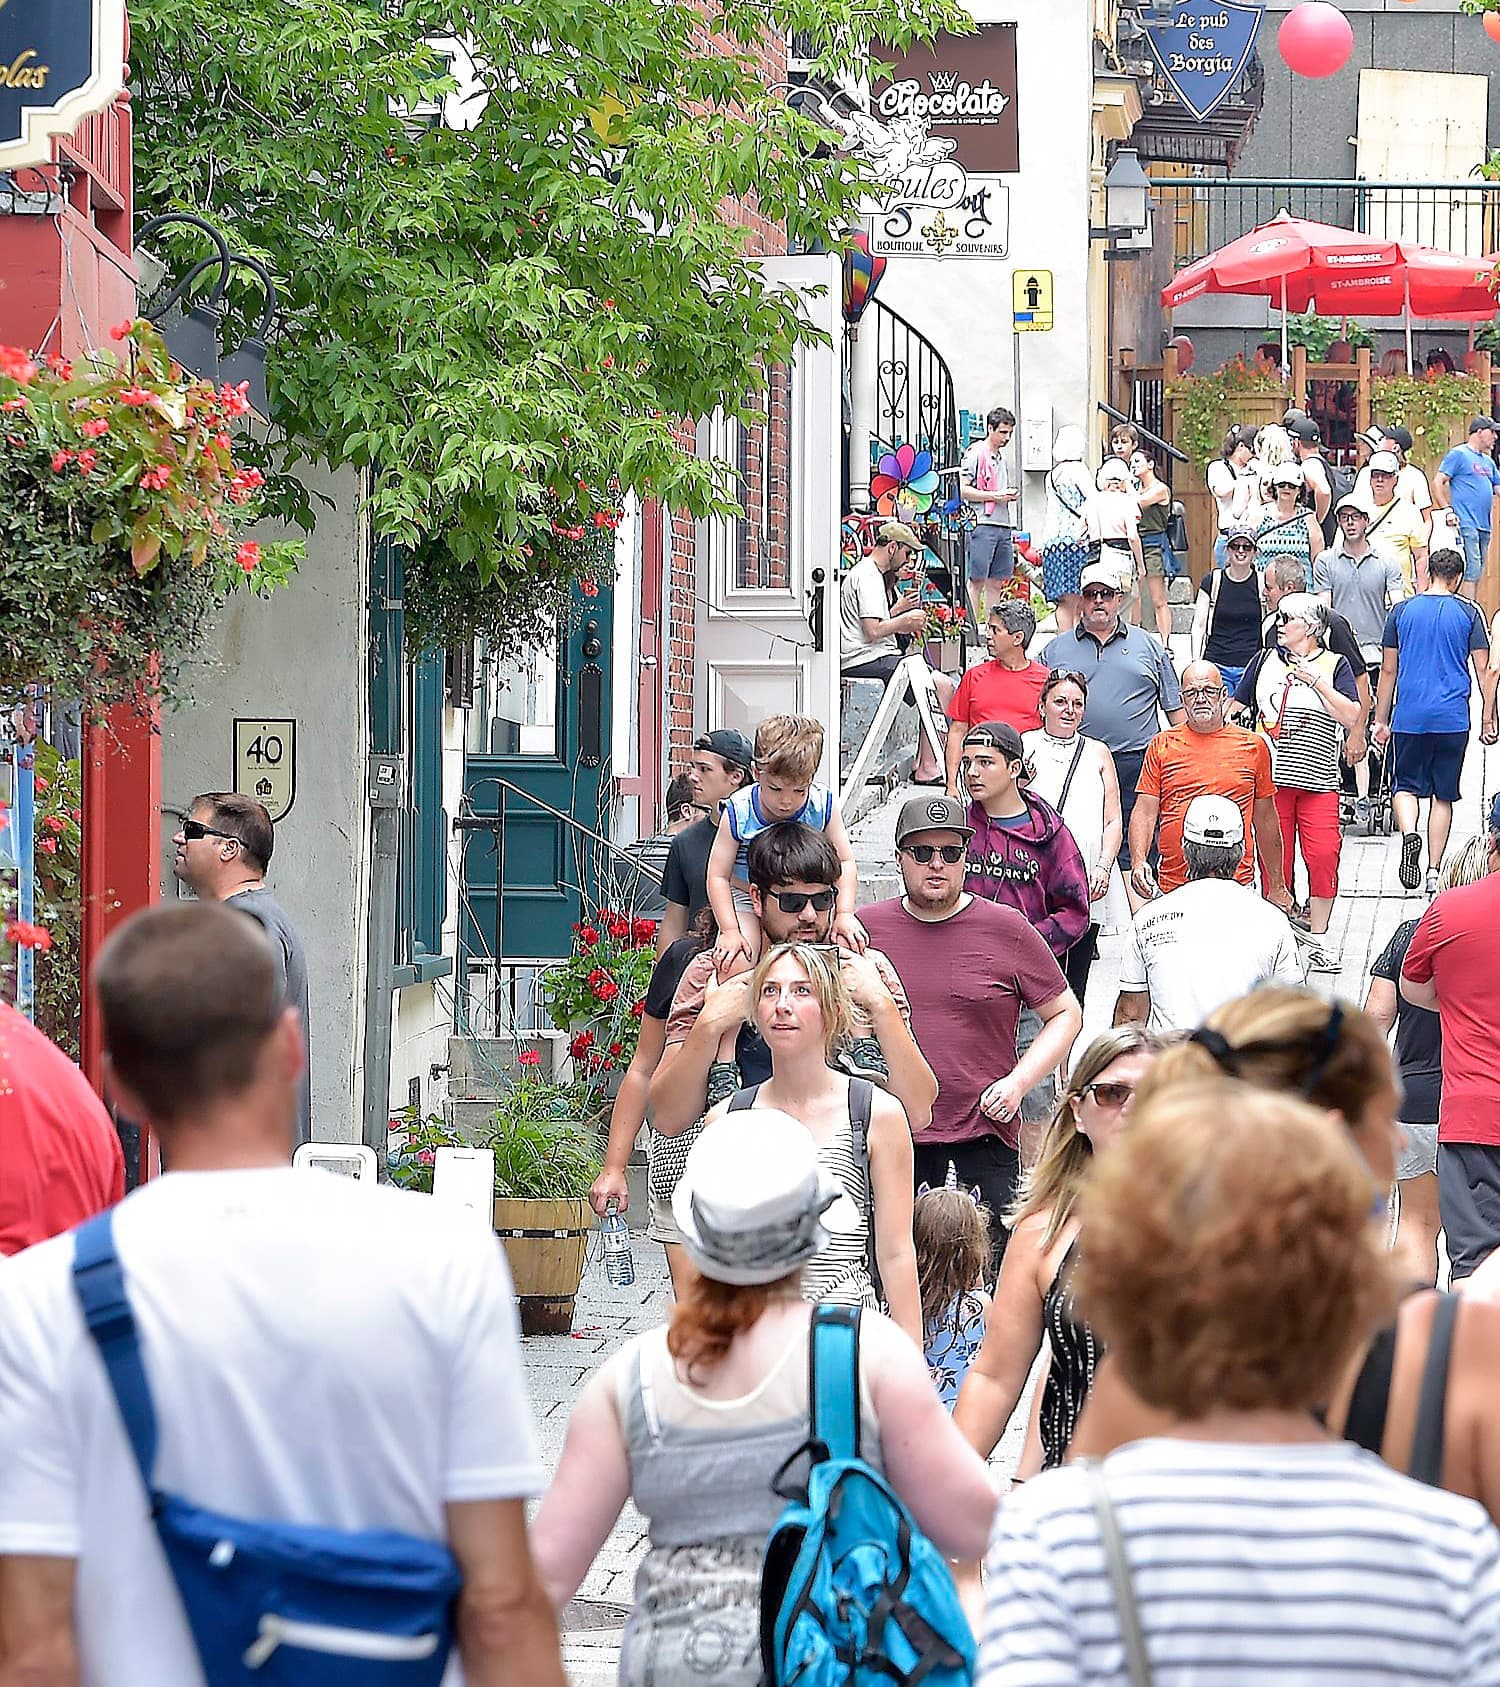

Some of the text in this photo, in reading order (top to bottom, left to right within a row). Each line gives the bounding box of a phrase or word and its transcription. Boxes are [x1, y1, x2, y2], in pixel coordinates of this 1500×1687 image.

[1175, 10, 1229, 31] Le pub
[1188, 32, 1214, 50] des
[1169, 52, 1233, 76] Borgia
[878, 79, 1010, 116] Chocolato
[877, 240, 1003, 254] BOUTIQUE SOUVENIRS
[1330, 275, 1392, 290] ST-AMBROISE
[246, 735, 283, 764] 40
